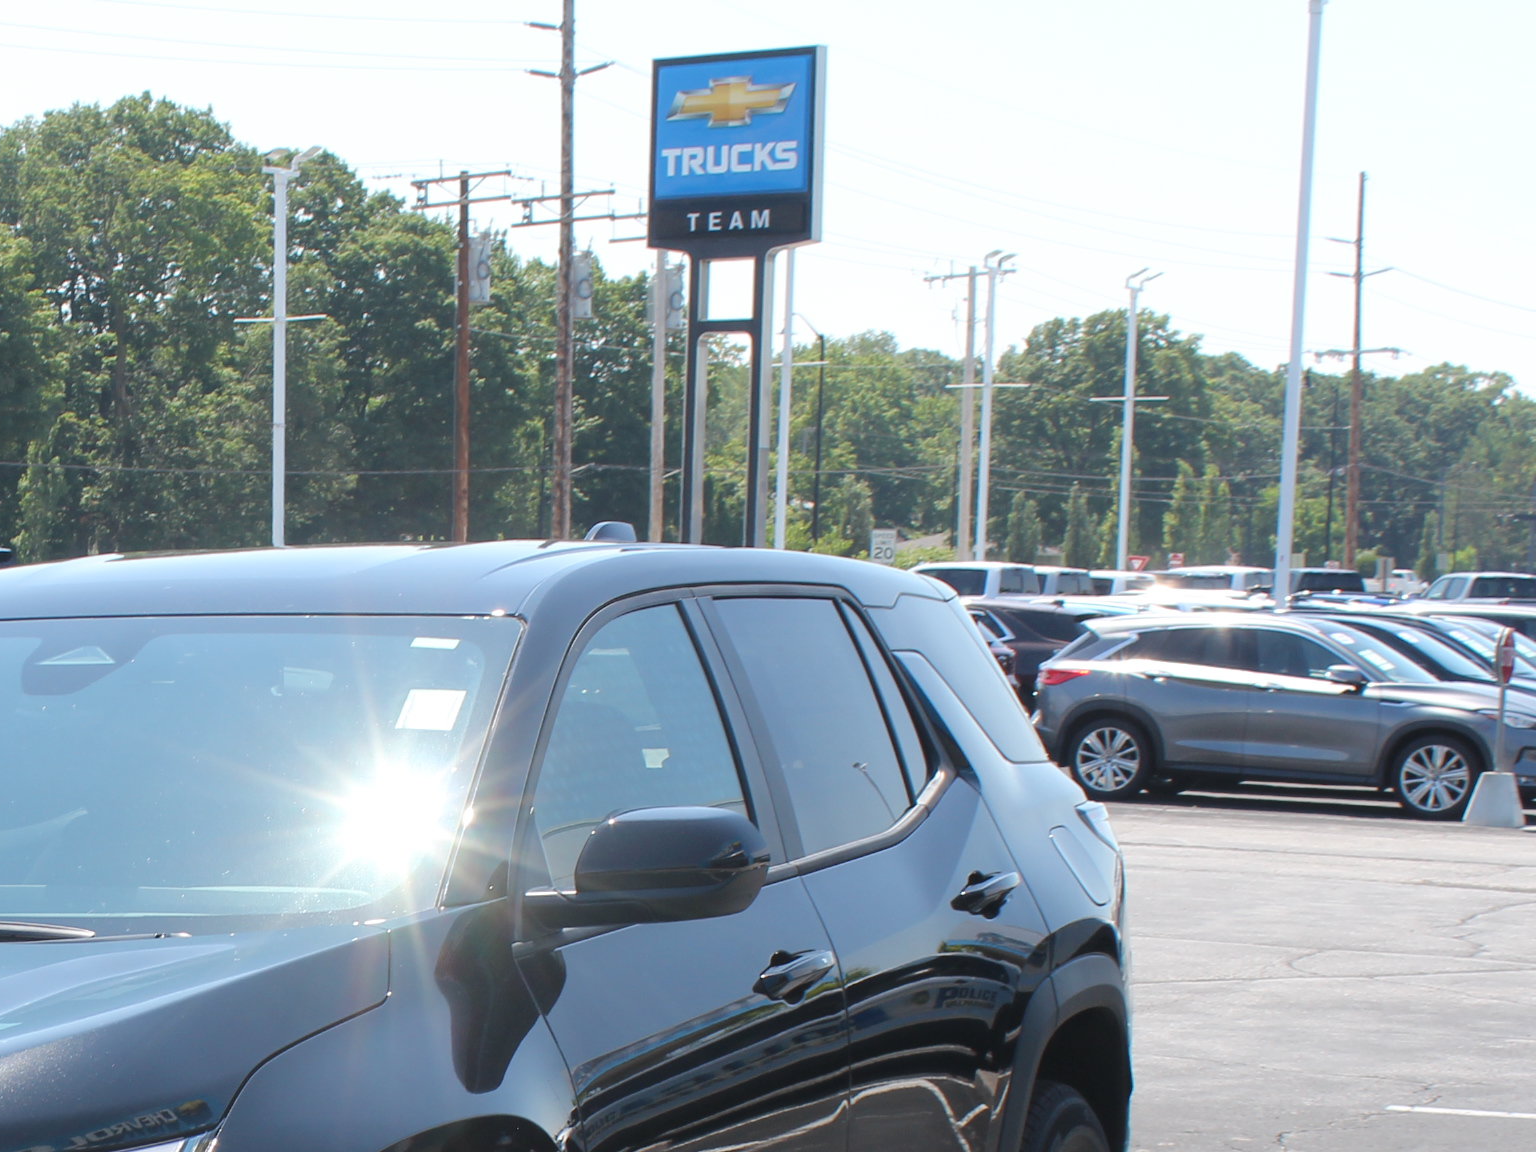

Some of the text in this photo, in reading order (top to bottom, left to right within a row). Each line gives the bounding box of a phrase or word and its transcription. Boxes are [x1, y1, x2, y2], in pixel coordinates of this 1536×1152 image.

[661, 140, 799, 177] TRUCKS
[686, 209, 771, 232] TEAM
[874, 546, 893, 560] 20
